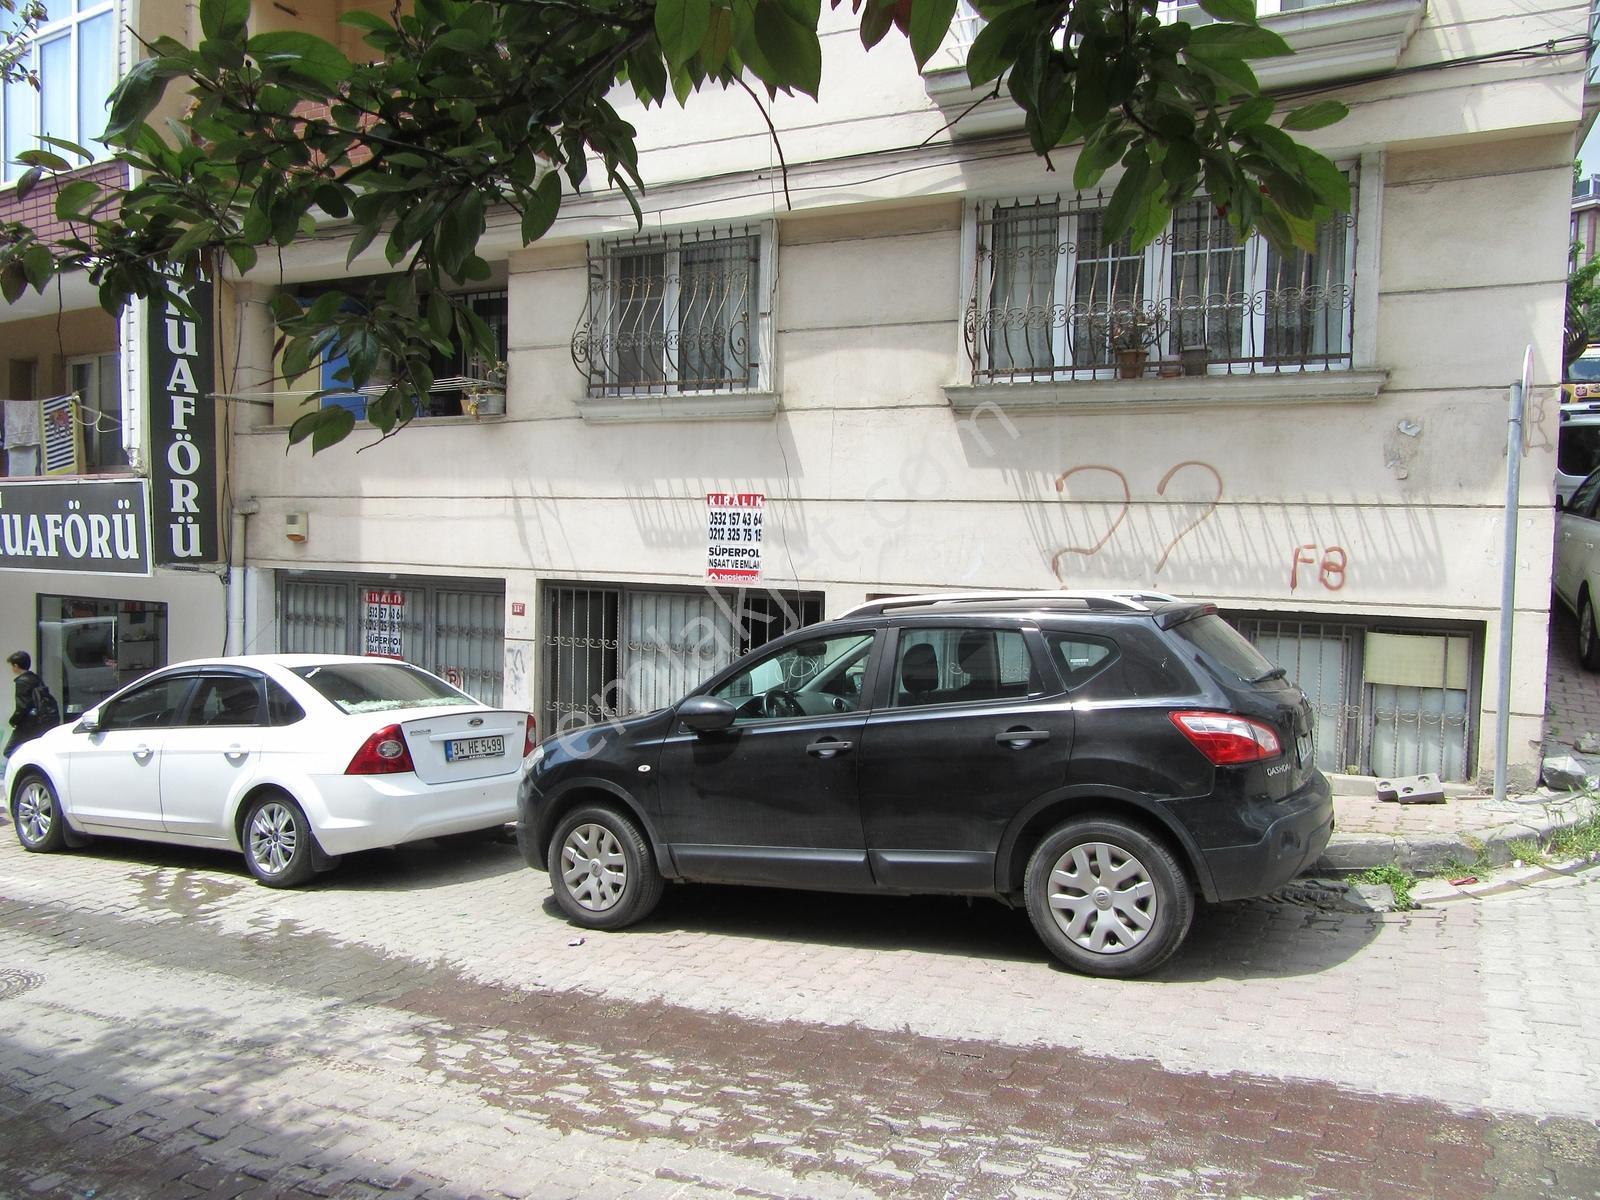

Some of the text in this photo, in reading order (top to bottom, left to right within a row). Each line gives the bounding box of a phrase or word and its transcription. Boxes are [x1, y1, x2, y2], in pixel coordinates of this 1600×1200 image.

[165, 279, 202, 557] KUAFÖRÜ
[709, 495, 763, 507] KIRALIK
[709, 511, 727, 525] 0532
[728, 512, 741, 526] 157
[742, 513, 752, 526] 43
[0, 499, 139, 560] UAFÖRÜ
[709, 527, 725, 540] 0212
[727, 528, 740, 541] 325
[743, 529, 752, 541] 75
[708, 545, 761, 558] SÜPERPOL
[731, 559, 739, 569] VE
[453, 738, 502, 755] 34 HE 5499
